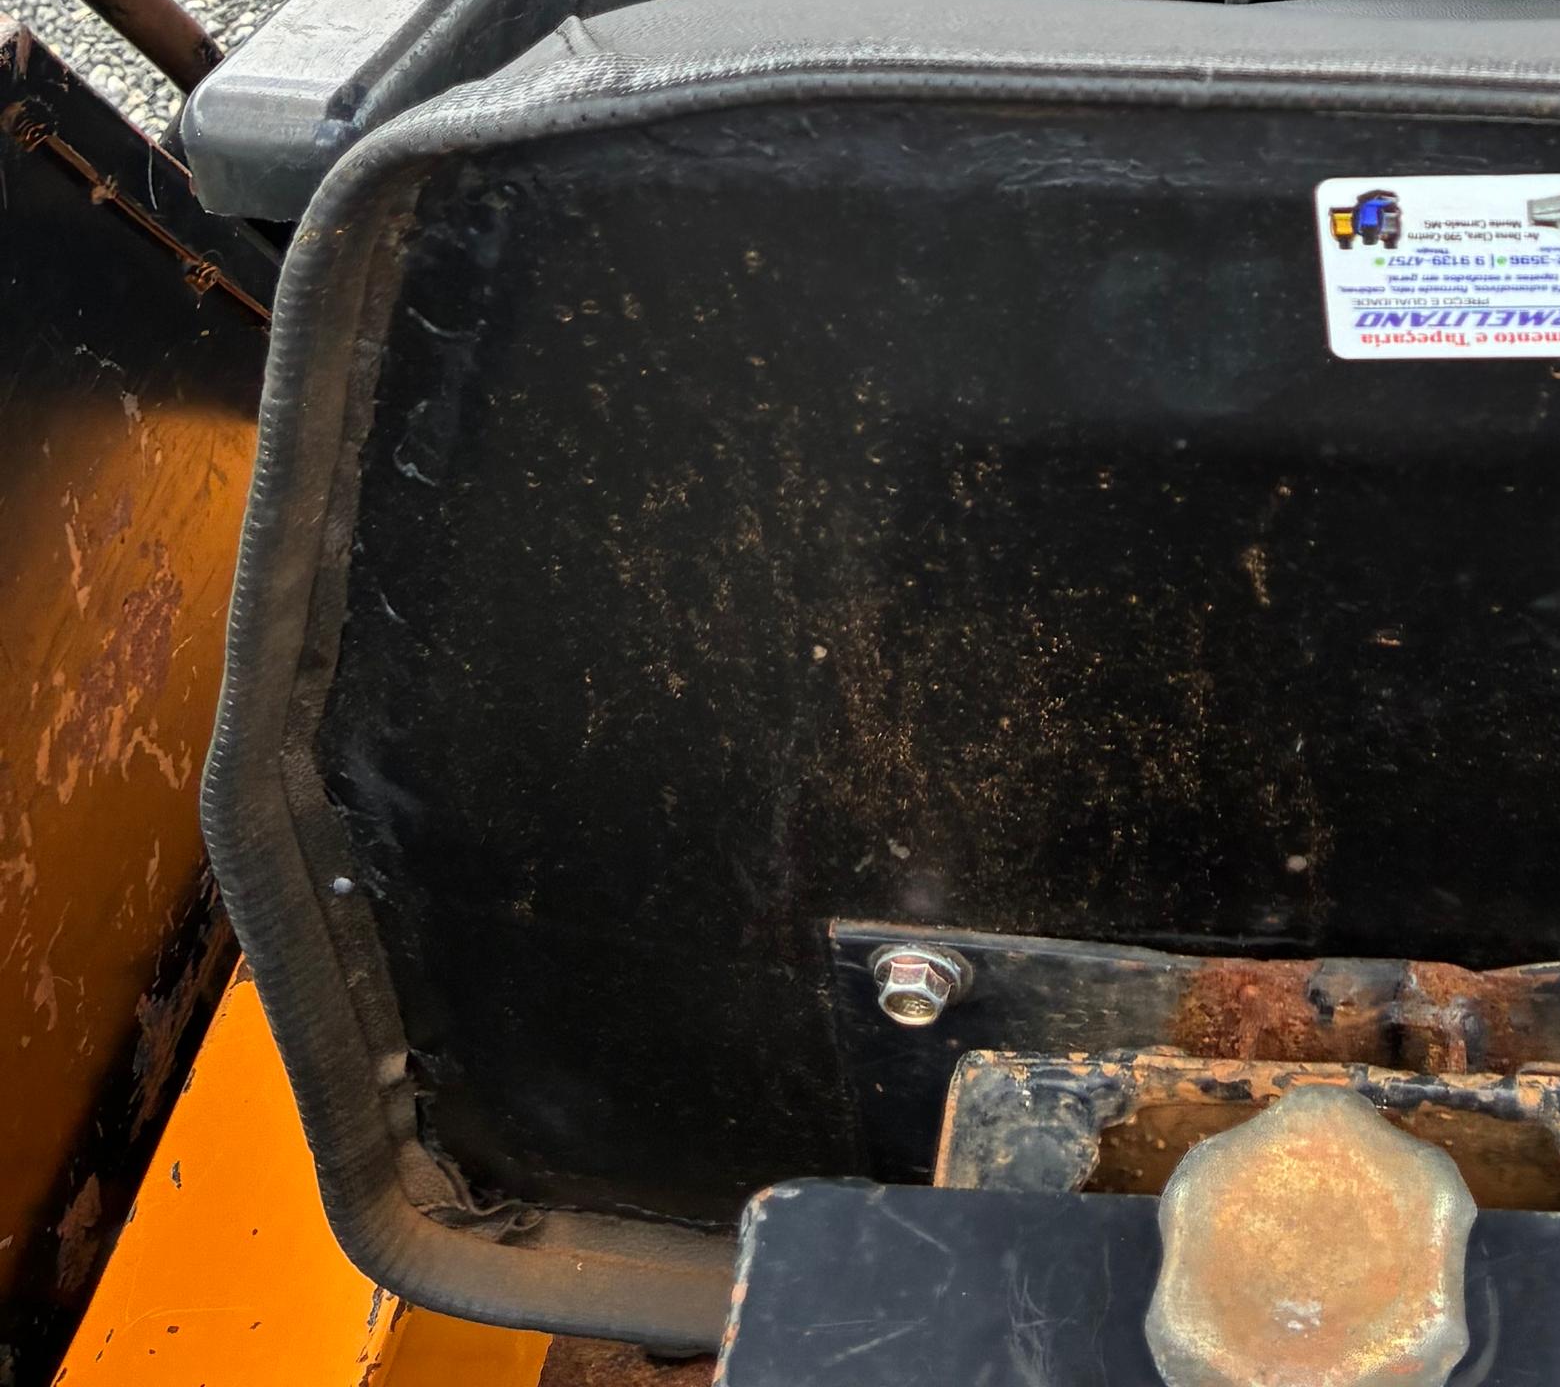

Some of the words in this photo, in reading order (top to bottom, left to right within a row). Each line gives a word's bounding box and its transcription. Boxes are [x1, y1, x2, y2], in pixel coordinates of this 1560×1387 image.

[1388, 257, 1469, 267] 9139-4757
[1476, 257, 1485, 266] 9
[1352, 298, 1427, 306] QUALIDADE
[1431, 298, 1439, 306] E
[1443, 297, 1489, 306] PREÇO
[1360, 330, 1469, 347] Tapeçaria
[1476, 333, 1487, 344] e
